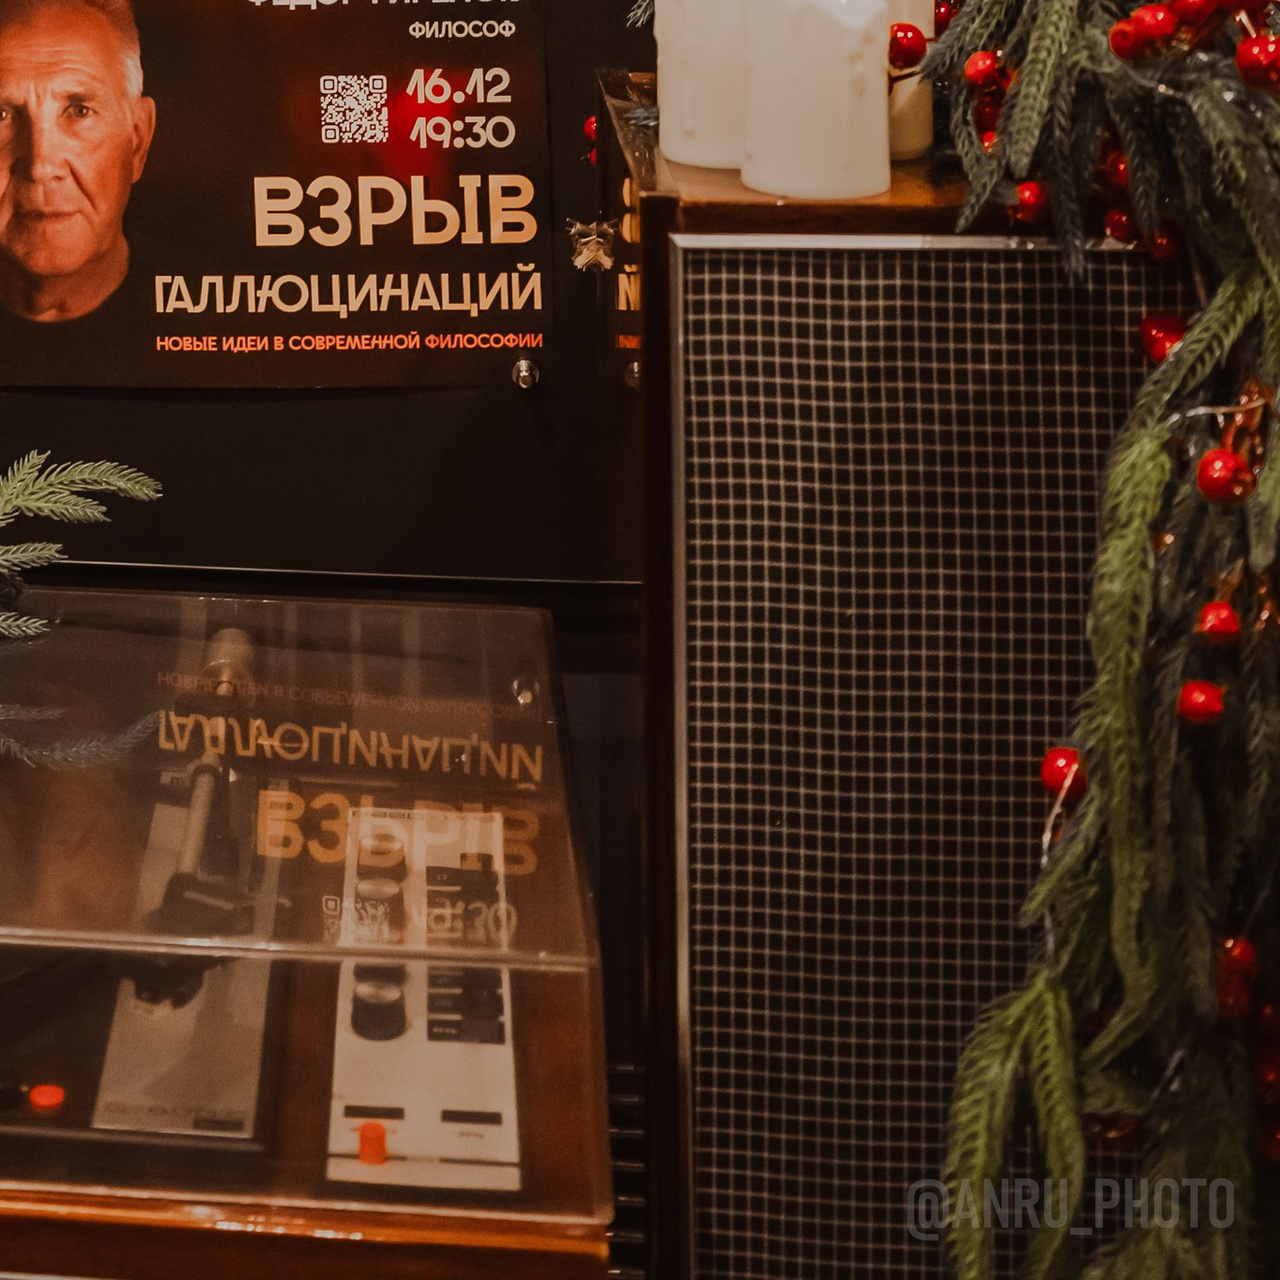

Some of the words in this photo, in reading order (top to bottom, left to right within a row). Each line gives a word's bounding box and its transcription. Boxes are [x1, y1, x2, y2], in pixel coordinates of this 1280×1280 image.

[408, 19, 516, 39] ФИЛОСОФ
[406, 67, 511, 105] 16.12
[409, 115, 516, 150] 19:30
[253, 173, 538, 248] ВЗРЫВ
[155, 262, 543, 319] ГАЛЛЮЦИНАЦИЙ
[156, 336, 218, 352] НОВЫЕ
[222, 336, 270, 354] ИДЕИ
[273, 336, 285, 351] В
[288, 330, 421, 352] СОВРЕМЕННОЙ
[424, 332, 544, 350] ФИЛОСОФИИ
